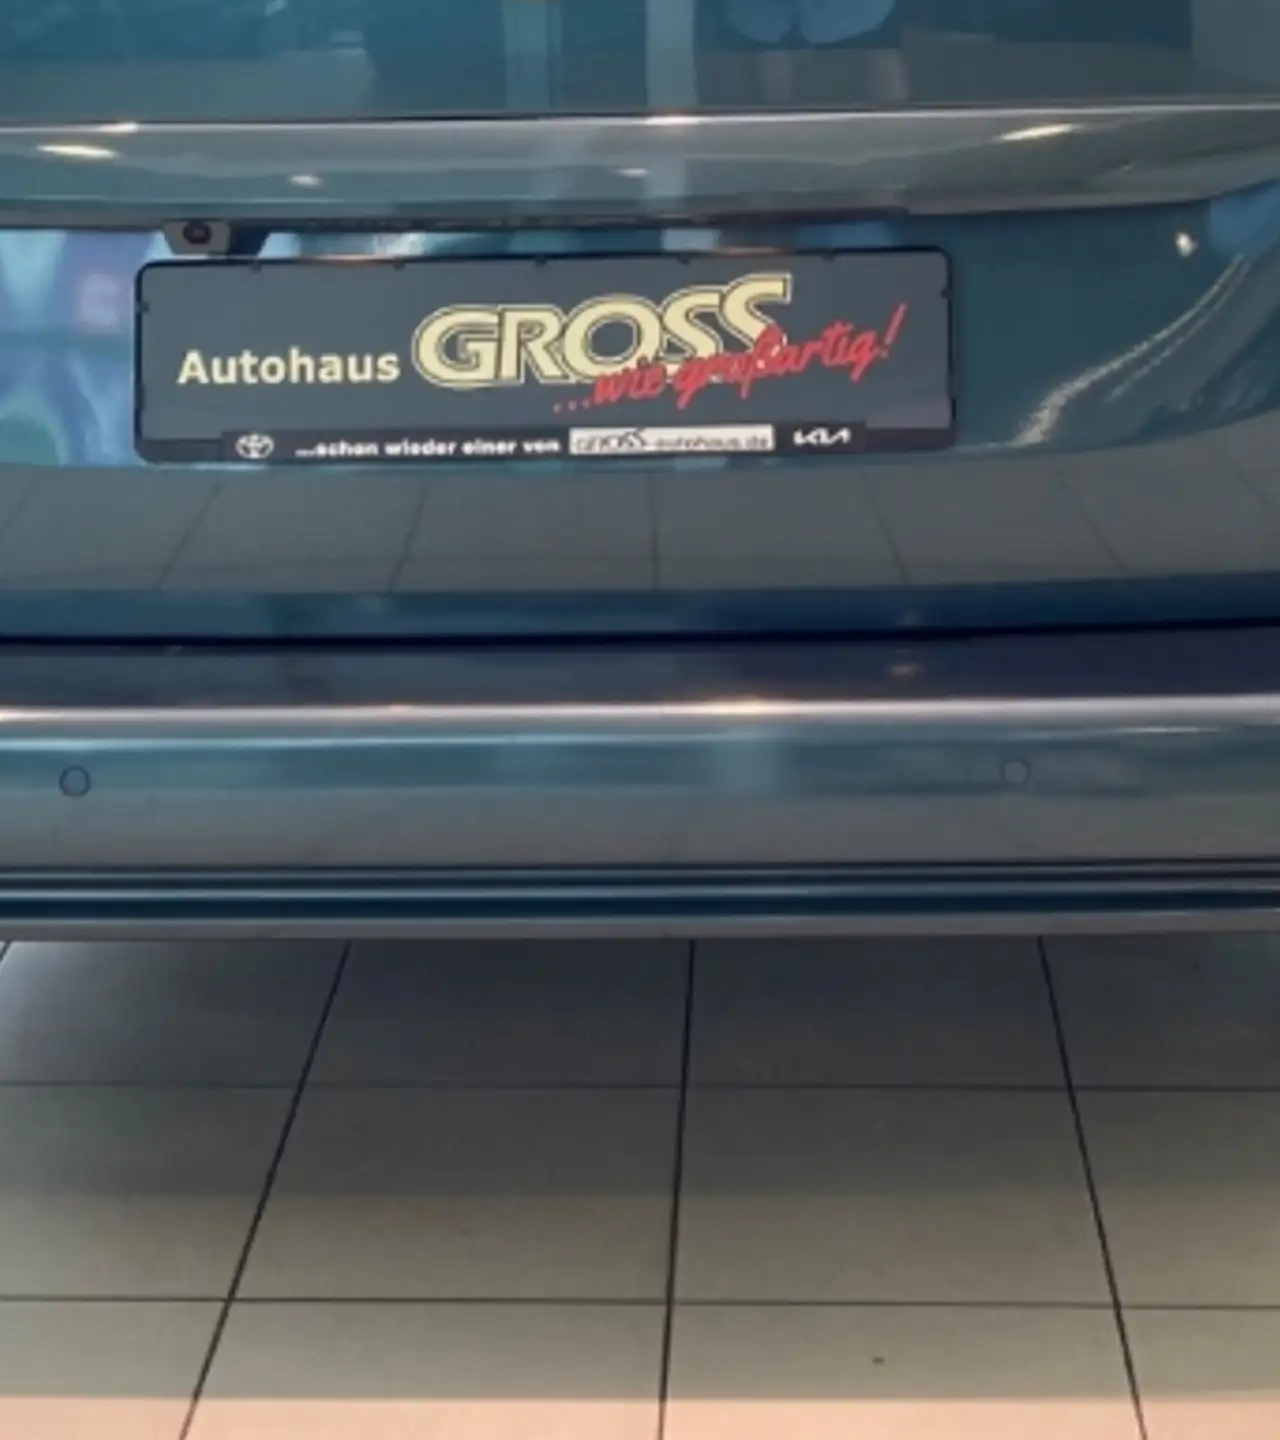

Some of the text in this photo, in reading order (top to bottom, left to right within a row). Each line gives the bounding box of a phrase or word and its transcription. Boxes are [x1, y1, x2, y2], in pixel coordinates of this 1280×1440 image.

[177, 272, 793, 390] Autohaus GROSS
[384, 438, 456, 456] wieder
[460, 438, 518, 455] einer
[523, 439, 561, 453] von
